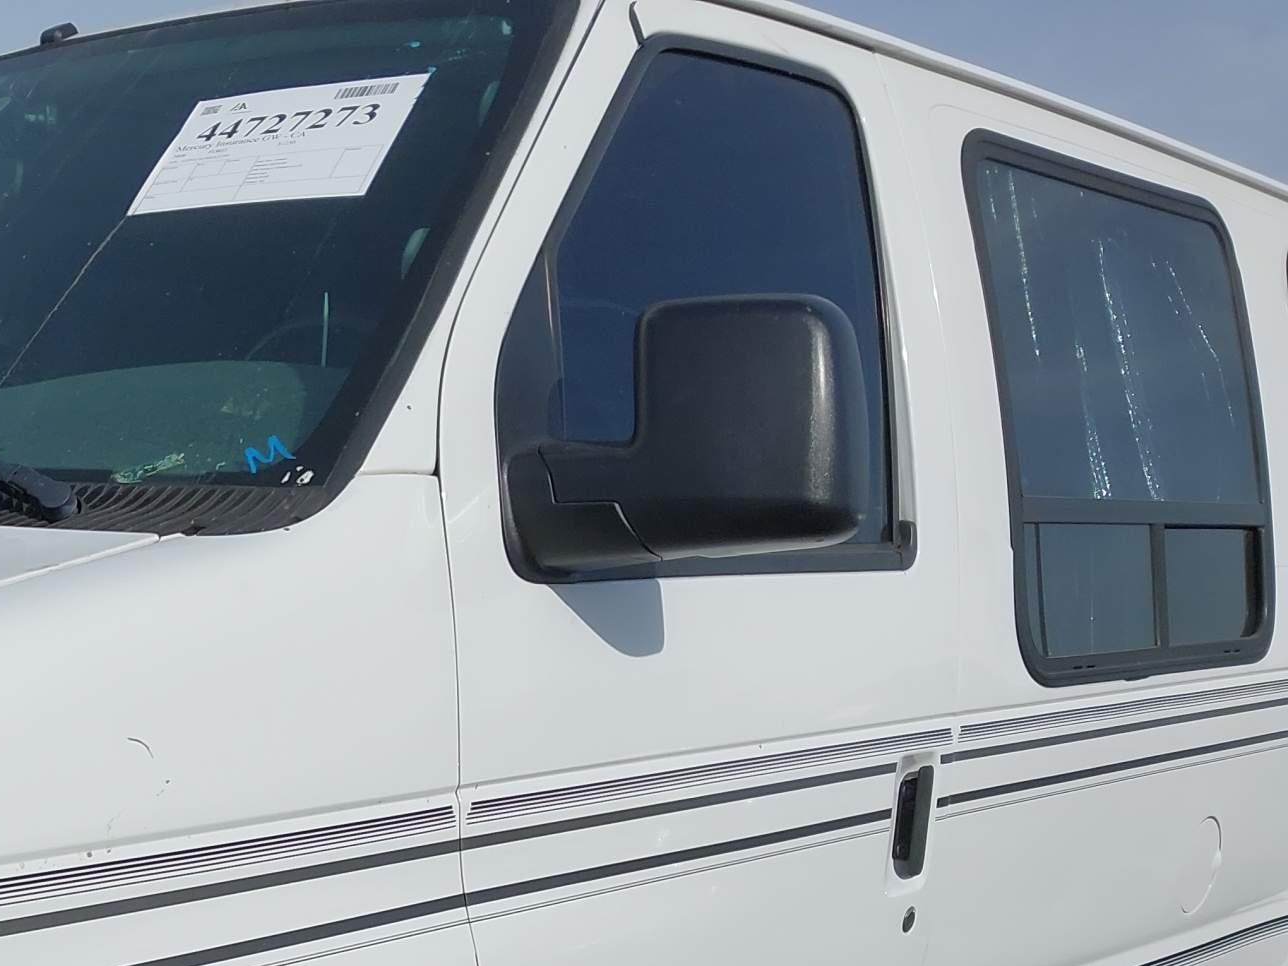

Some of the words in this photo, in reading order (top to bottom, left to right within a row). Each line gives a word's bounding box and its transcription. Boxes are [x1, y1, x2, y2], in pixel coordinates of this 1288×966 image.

[196, 103, 381, 142] 44727273
[176, 143, 212, 153] Mercury
[216, 137, 261, 147] Insurance
